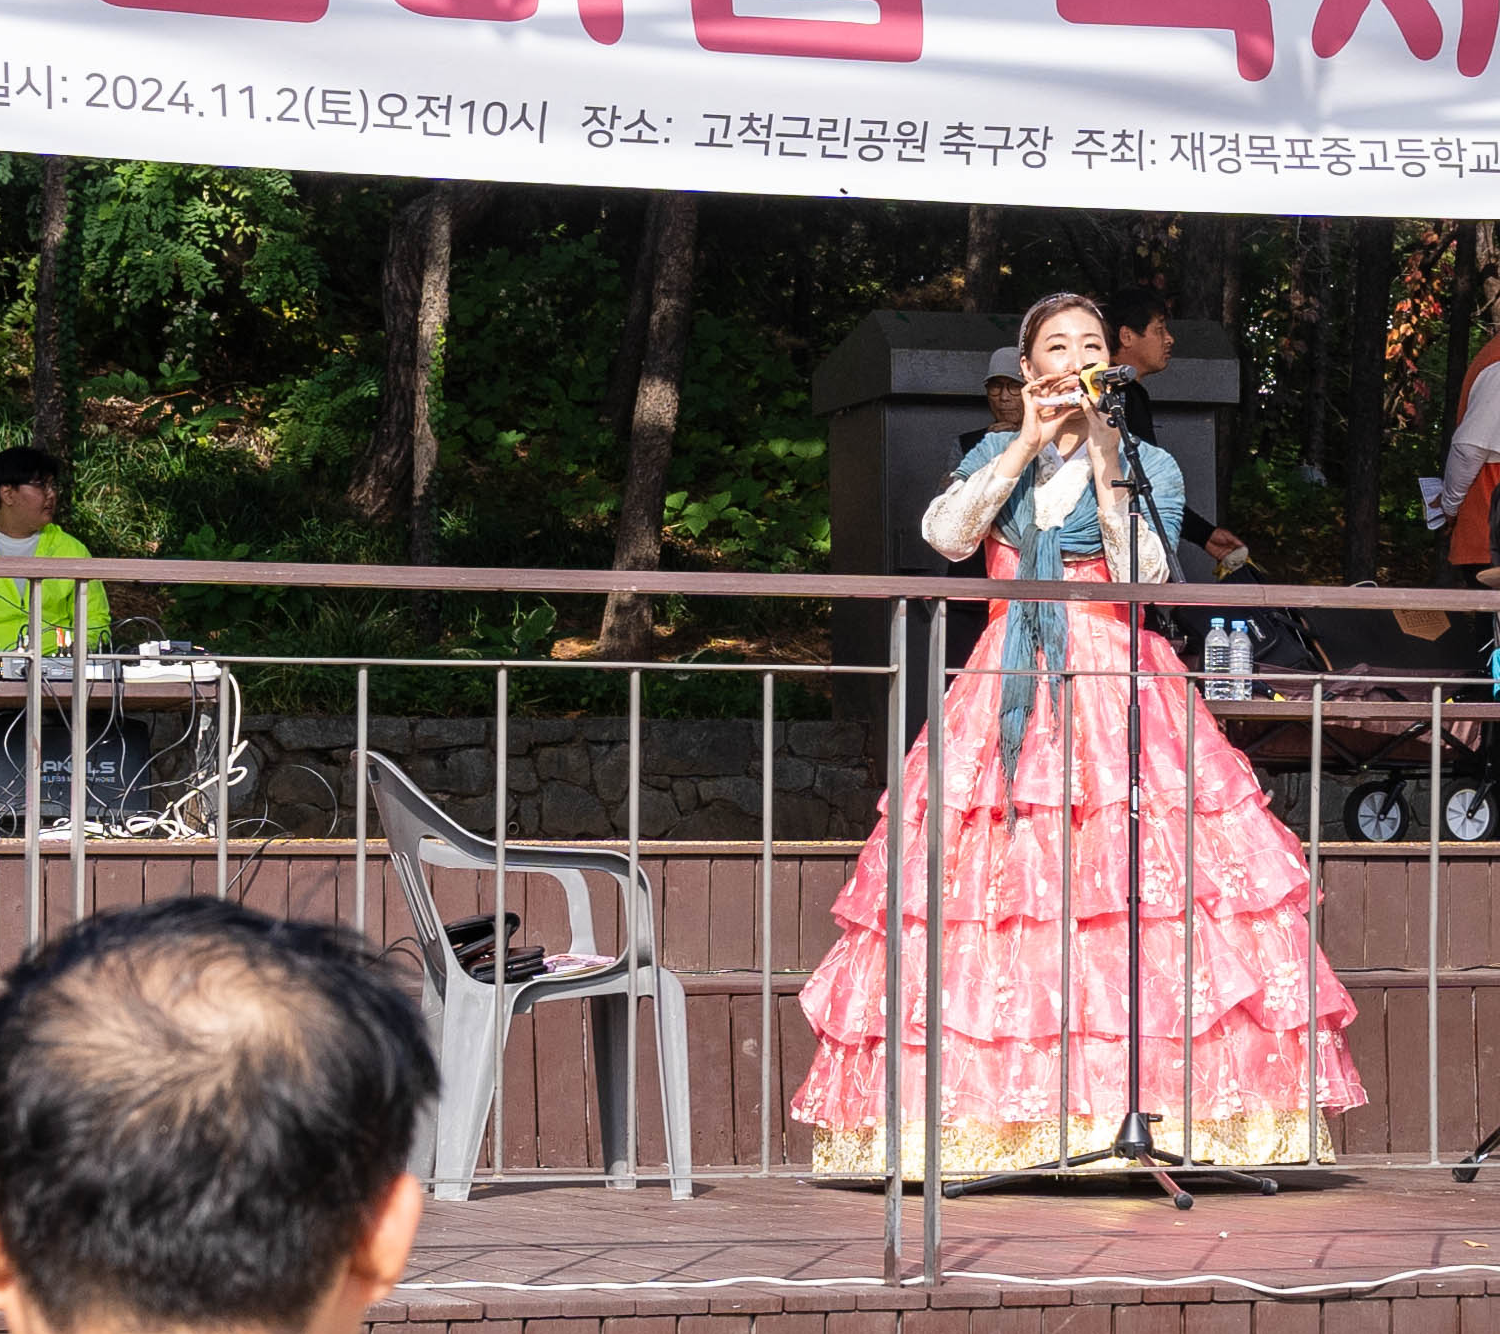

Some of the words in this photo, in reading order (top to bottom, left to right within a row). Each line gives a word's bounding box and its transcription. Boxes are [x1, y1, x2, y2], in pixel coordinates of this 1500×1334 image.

[85, 72, 548, 144] 2024.11.2(토)오전10시
[579, 104, 673, 149] 장소:
[693, 111, 929, 164] 고척근린공원
[939, 121, 1054, 170] 축구장
[1070, 128, 1157, 172] 주최:
